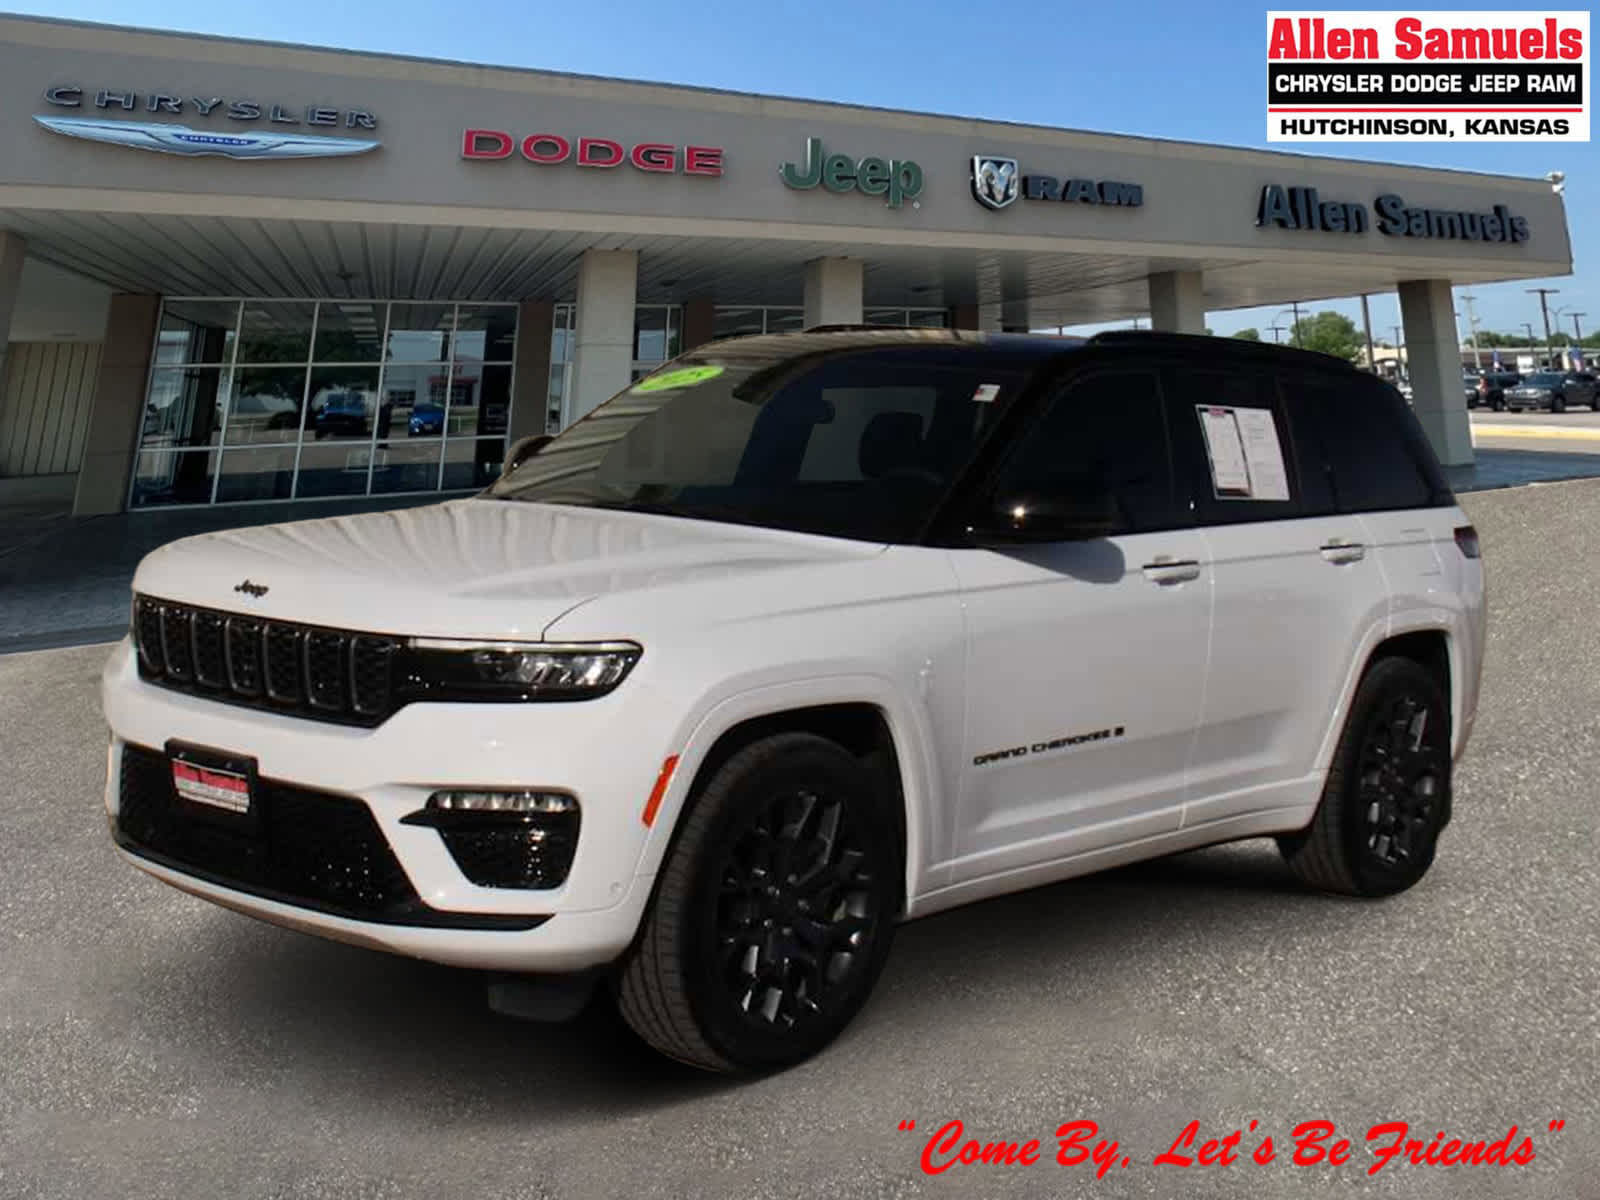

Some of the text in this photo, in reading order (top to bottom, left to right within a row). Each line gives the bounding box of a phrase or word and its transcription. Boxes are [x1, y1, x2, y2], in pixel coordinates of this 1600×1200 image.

[44, 86, 378, 130] CHRYSLER
[461, 128, 724, 176] DODGE
[780, 137, 924, 209] Jeep
[1023, 175, 1143, 207] RAM
[1256, 184, 1529, 243] Allen Samuels
